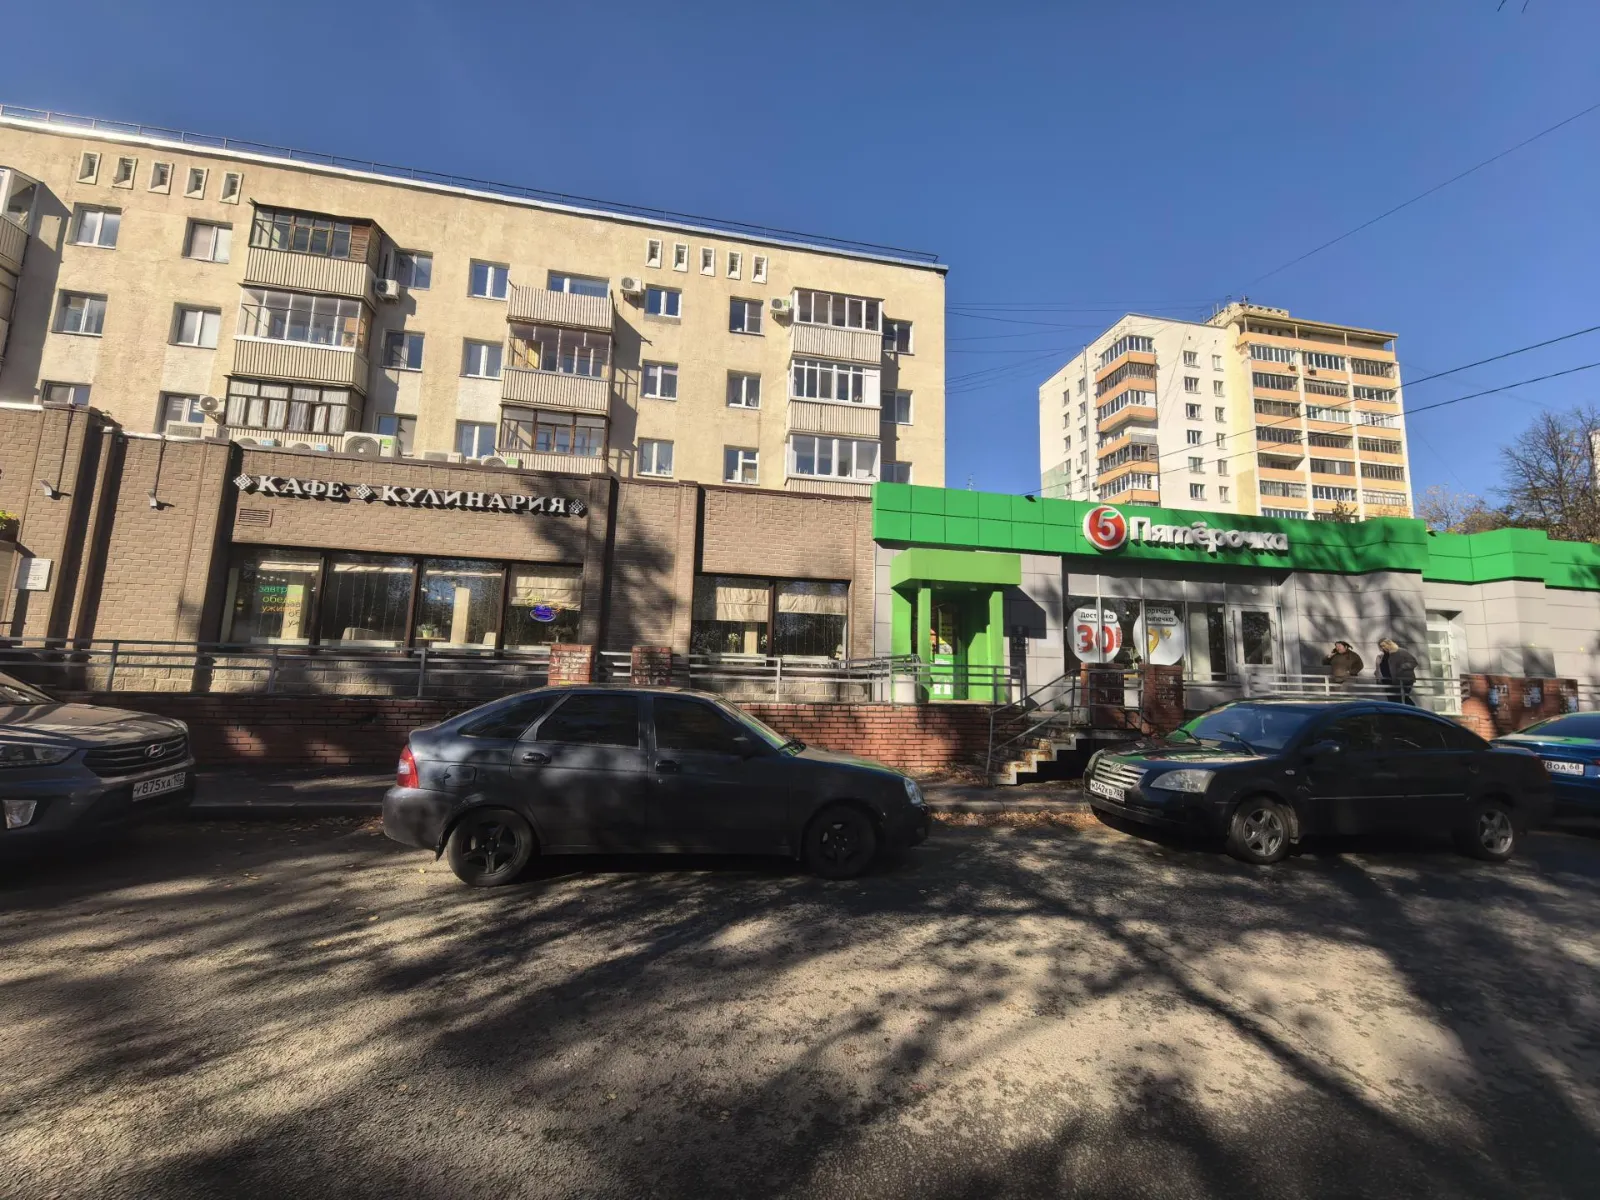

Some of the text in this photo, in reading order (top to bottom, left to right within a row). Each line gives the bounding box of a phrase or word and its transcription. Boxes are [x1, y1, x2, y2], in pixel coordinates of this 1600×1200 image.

[257, 475, 566, 513] КАФЕ КУЛИНАРИЯ
[1129, 516, 1288, 553] Пятёрочка
